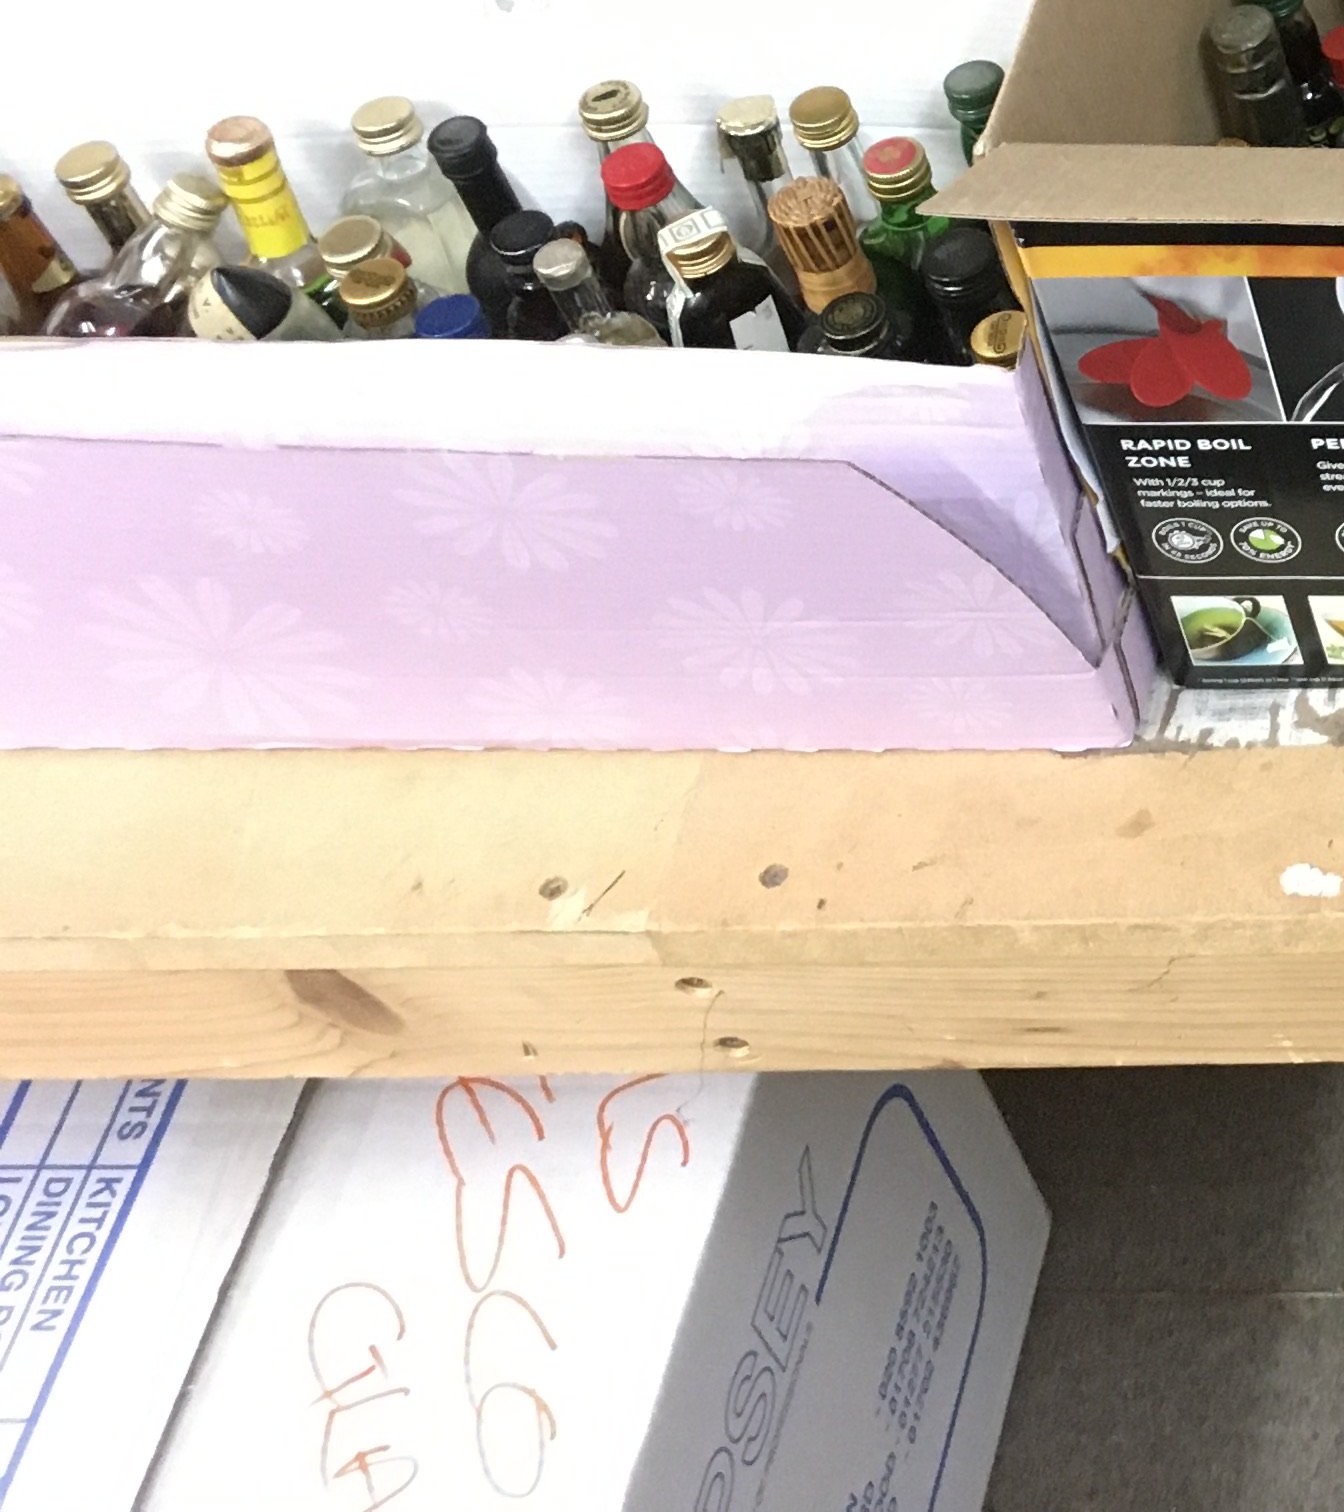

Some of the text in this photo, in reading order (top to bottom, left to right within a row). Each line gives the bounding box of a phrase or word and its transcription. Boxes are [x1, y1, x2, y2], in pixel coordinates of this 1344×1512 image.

[1120, 439, 1252, 451] RAPID BOIL
[1125, 456, 1191, 468] ZONE
[1133, 478, 1225, 488] With 1/2/3 cup
[1137, 489, 1194, 498] markings
[1206, 489, 1235, 497] ideal
[1238, 489, 1255, 497] for
[1140, 499, 1272, 509] faster boiling options.
[1, 1177, 74, 1292] DINING
[30, 1177, 123, 1332] KITCHEN
